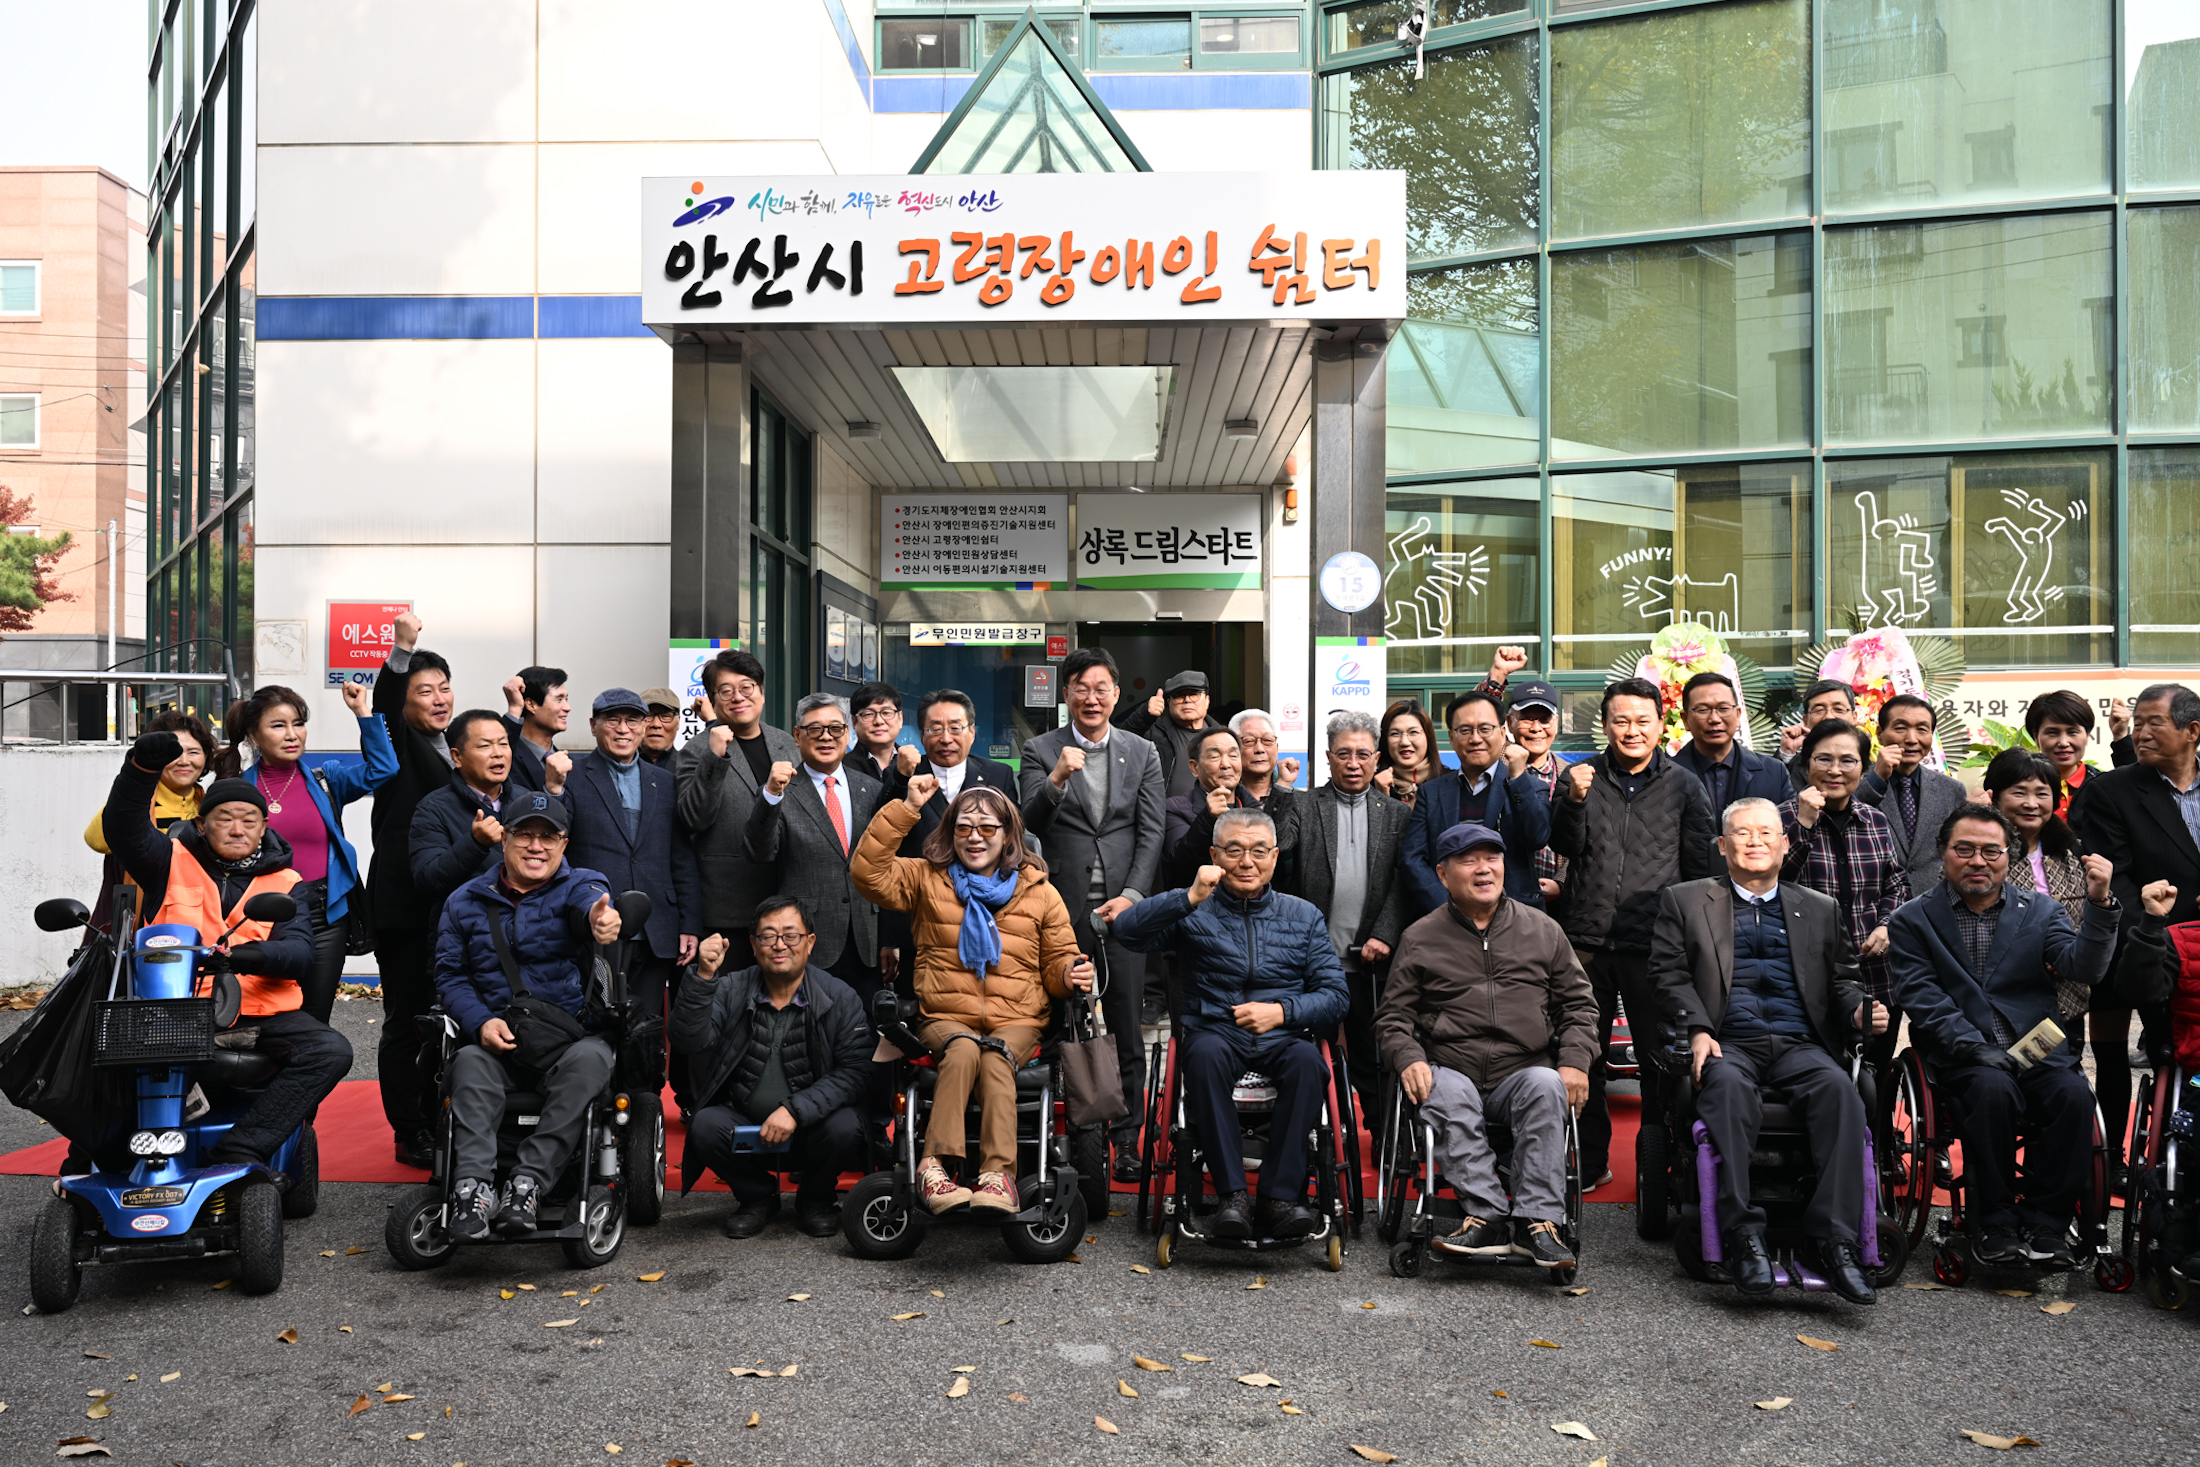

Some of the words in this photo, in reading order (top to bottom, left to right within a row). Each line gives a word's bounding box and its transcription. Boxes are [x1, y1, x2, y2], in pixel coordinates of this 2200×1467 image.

[748, 187, 799, 222] 시민과
[842, 191, 892, 219] 자유로운
[898, 190, 954, 217] 혁신도시
[958, 190, 1004, 213] 안산
[666, 233, 865, 308] 안산시
[894, 230, 1222, 305] 고령장애인
[1249, 223, 1381, 306] 쉼터
[902, 505, 996, 516] 경기도지체장애인협회
[999, 505, 1046, 516] 안산시지회
[902, 520, 930, 531] 안산시
[933, 520, 1056, 531] 장애인편의증진기술지원센터
[902, 535, 930, 546] 안산시
[932, 535, 999, 546] 고령장애인쉼터
[1079, 527, 1129, 565] 상록
[1130, 526, 1258, 566] 드림스타트
[902, 550, 930, 560] 안산시
[932, 550, 1018, 560] 장애인민원상담센터
[1599, 546, 1673, 579] FUNNY!
[902, 564, 930, 575] 안산시
[932, 564, 1046, 575] 이동편의시설기술지원센터
[1339, 576, 1363, 593] 15
[342, 623, 396, 645] 에스원
[932, 628, 1042, 640] 무인민원발급창구
[350, 650, 369, 658] CCTV
[369, 650, 388, 658] 작동중
[329, 672, 374, 684] SECOM
[1332, 686, 1370, 696] KAPPD
[128, 1192, 155, 1201] VICTORY
[165, 1190, 178, 1198] 007
